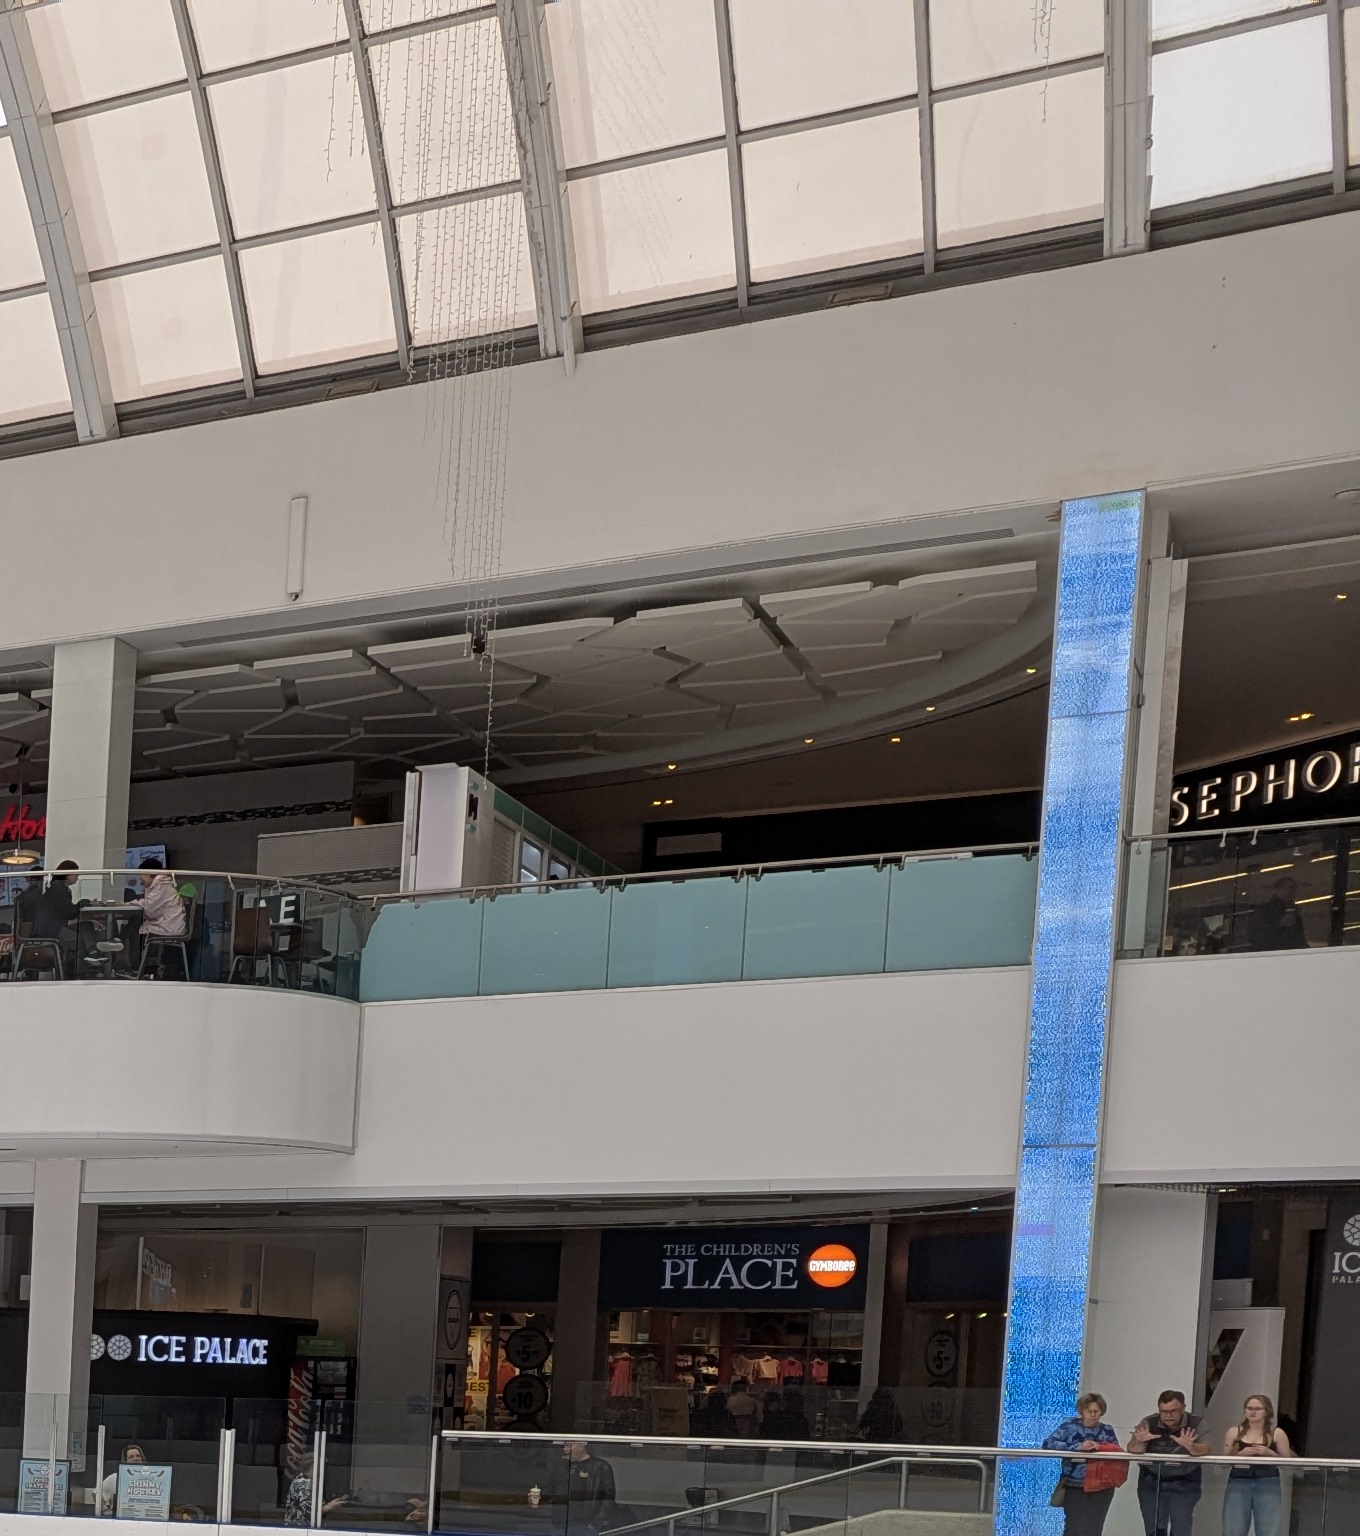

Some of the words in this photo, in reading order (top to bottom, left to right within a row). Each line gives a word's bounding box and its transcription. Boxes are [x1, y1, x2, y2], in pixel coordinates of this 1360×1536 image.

[664, 1244, 696, 1255] THE
[700, 1243, 800, 1256] CHILDREN'S
[661, 1258, 798, 1290] PLACE
[137, 1334, 186, 1362] ICE
[192, 1336, 268, 1365] PALACE
